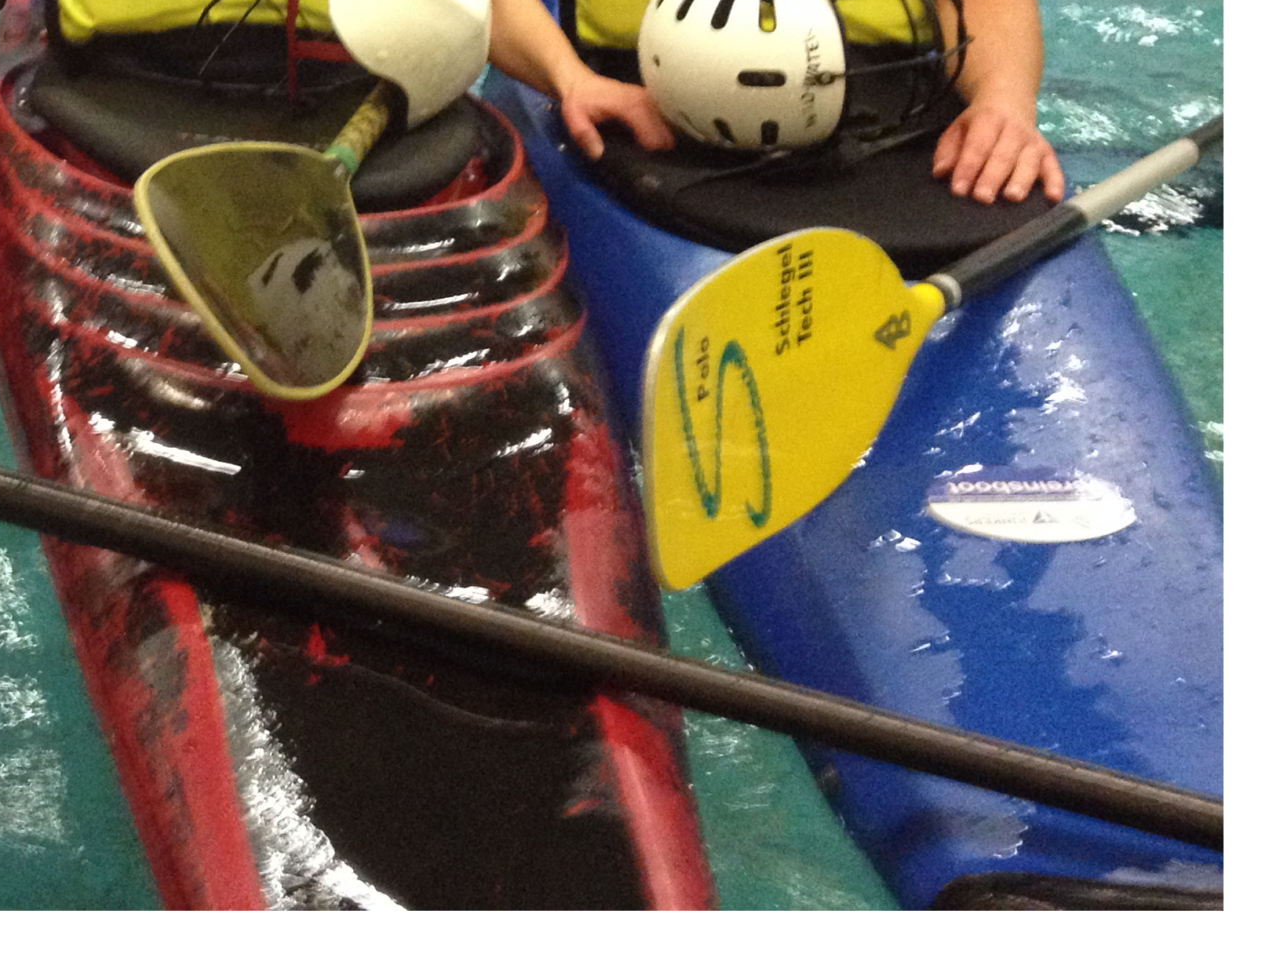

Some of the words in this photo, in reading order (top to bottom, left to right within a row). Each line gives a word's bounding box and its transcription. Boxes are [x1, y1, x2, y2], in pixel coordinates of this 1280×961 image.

[797, 250, 814, 282] III
[775, 242, 796, 356] Schlegel
[797, 287, 814, 347] Tech
[695, 335, 710, 402] Polo
[947, 480, 1086, 495] ereinsboot
